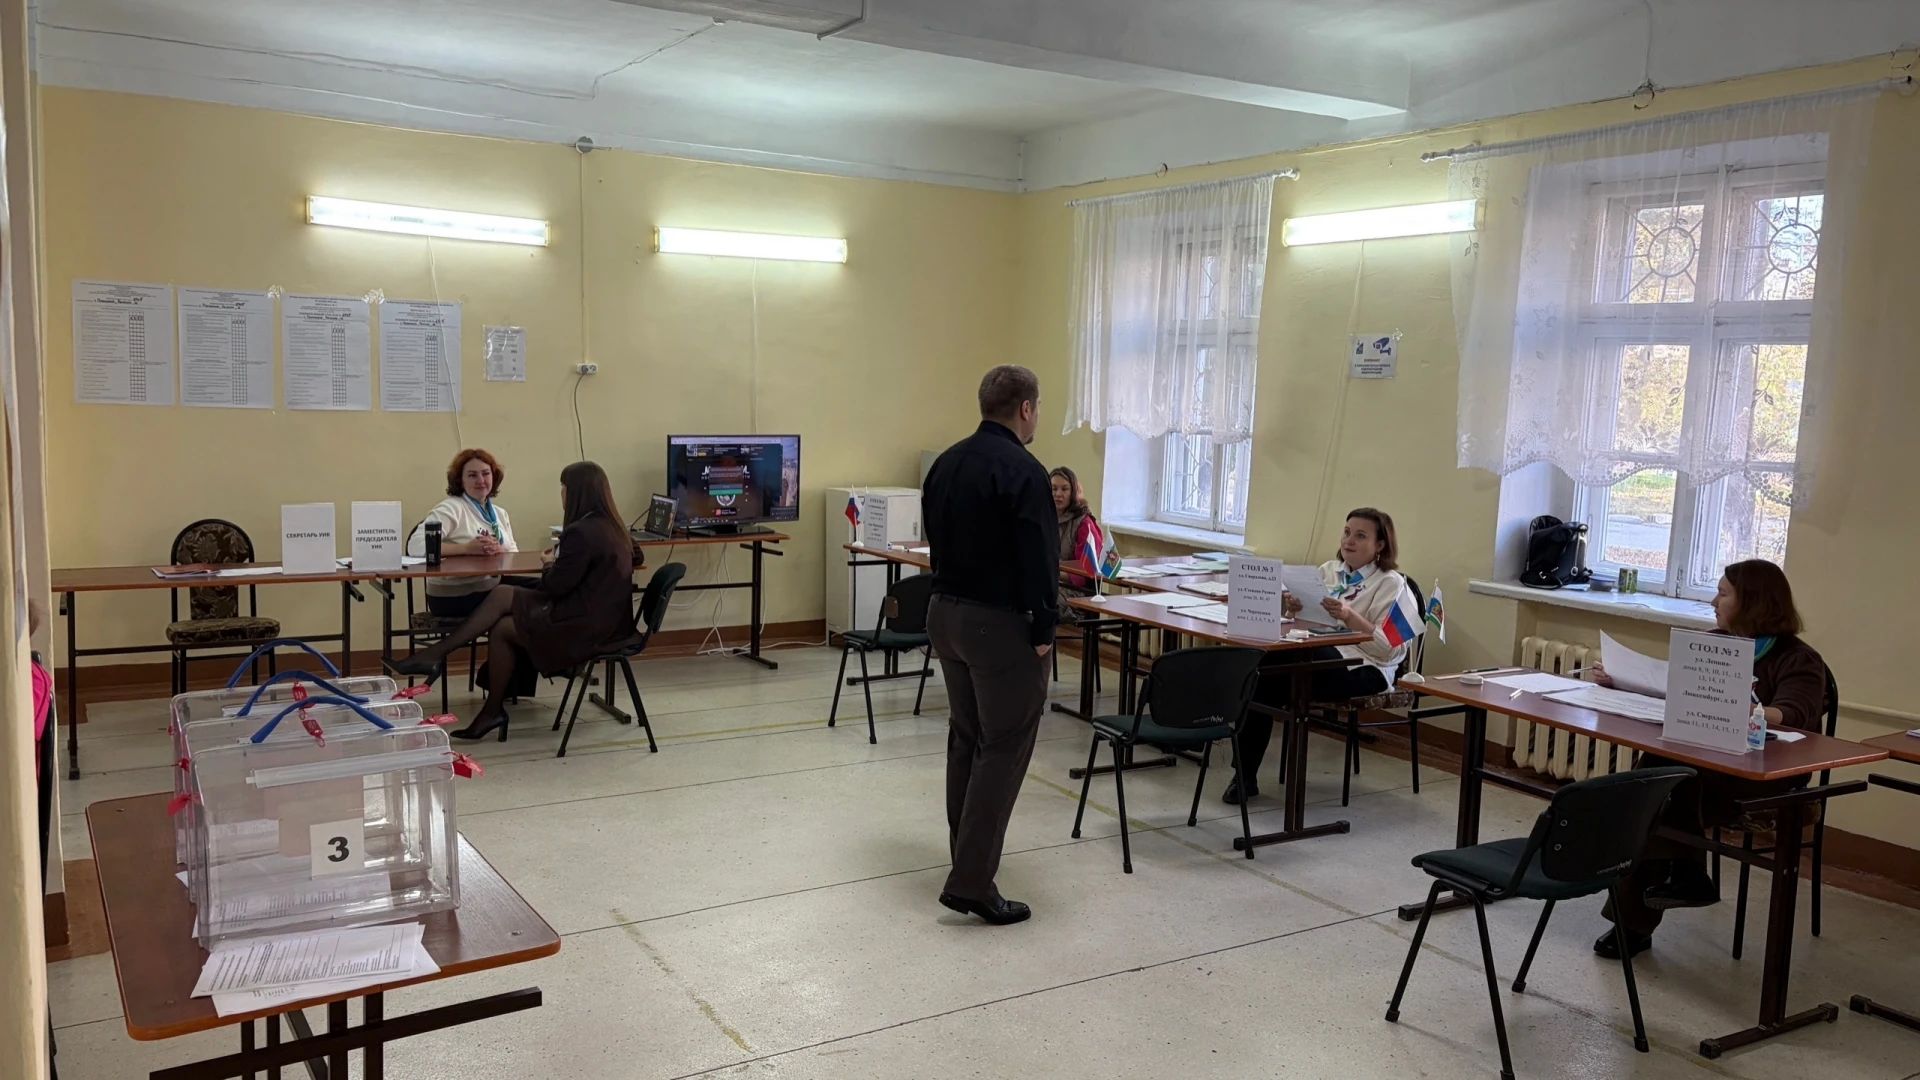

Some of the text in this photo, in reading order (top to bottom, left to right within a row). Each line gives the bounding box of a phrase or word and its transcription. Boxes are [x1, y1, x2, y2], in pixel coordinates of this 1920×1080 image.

[1241, 563, 1260, 572] СТОЛ
[1261, 565, 1269, 573] №
[1689, 642, 1740, 657] СТОЛ № 2
[1708, 676, 1717, 684] 14,
[1712, 668, 1720, 676] 10,
[1722, 669, 1731, 677] 11,
[1734, 671, 1743, 680] 12,
[1708, 685, 1724, 694] Розы
[1696, 711, 1731, 723] Свердлова
[1676, 718, 1690, 726] дома
[1691, 720, 1700, 728] 11,
[1701, 721, 1710, 729] 13,
[1712, 723, 1720, 732] 14,
[1722, 725, 1731, 734] 15,
[327, 836, 350, 863] 3
